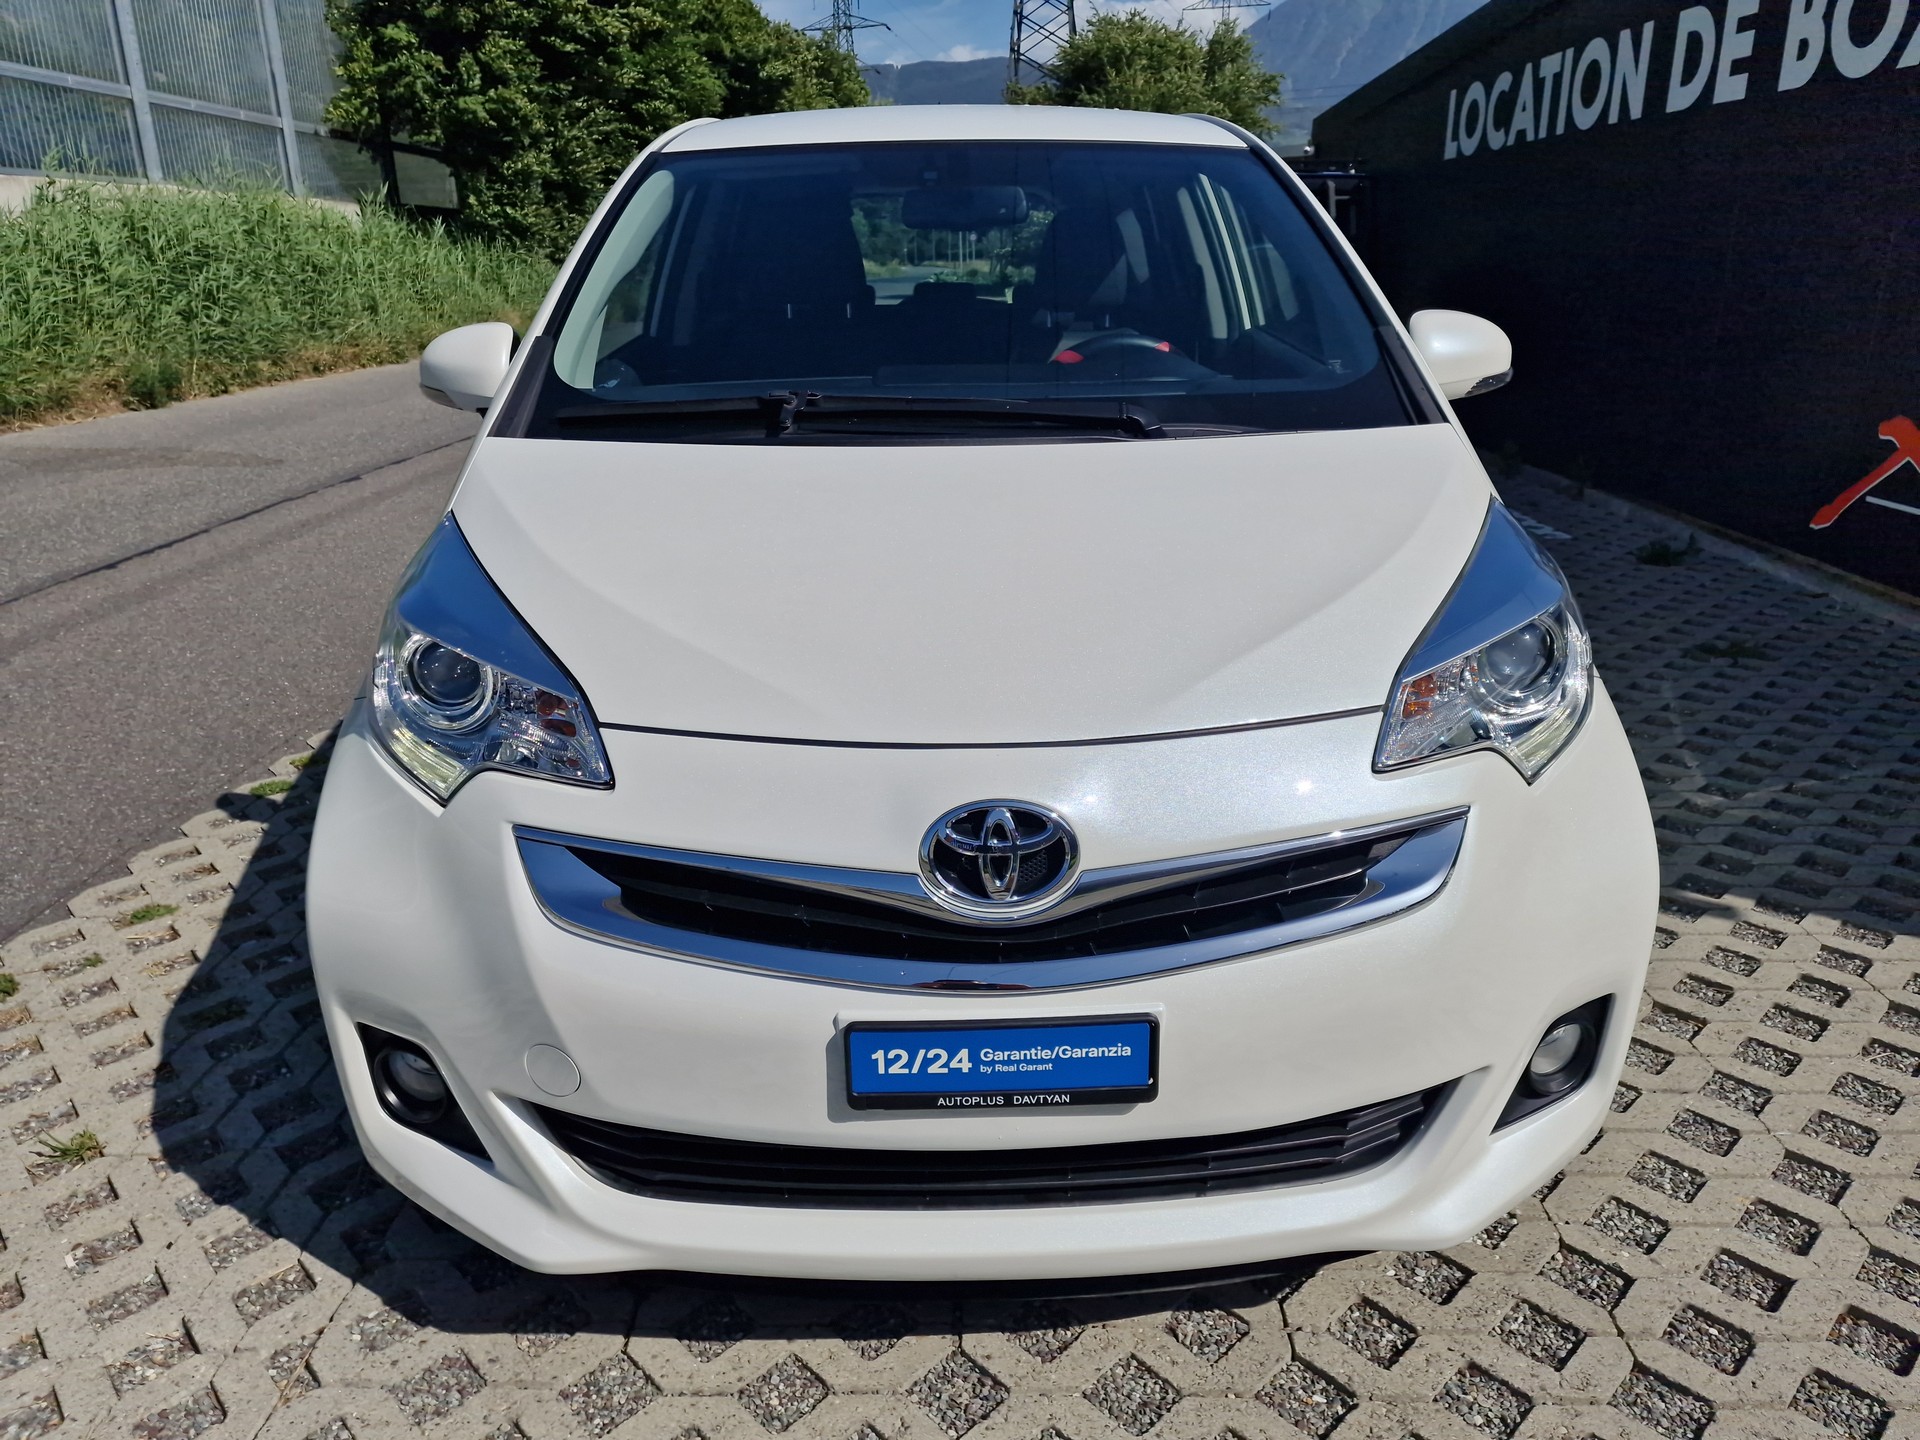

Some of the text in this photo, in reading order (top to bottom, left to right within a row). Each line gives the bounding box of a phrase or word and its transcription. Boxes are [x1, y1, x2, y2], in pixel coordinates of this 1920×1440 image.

[1443, 0, 1920, 160] LOCATION DE BO
[872, 1043, 1132, 1074] 12/24 Garantie/Garanzia
[979, 1062, 1053, 1074] by Real Garant
[937, 1094, 1070, 1106] AUTOPLUS DAVTYAN
